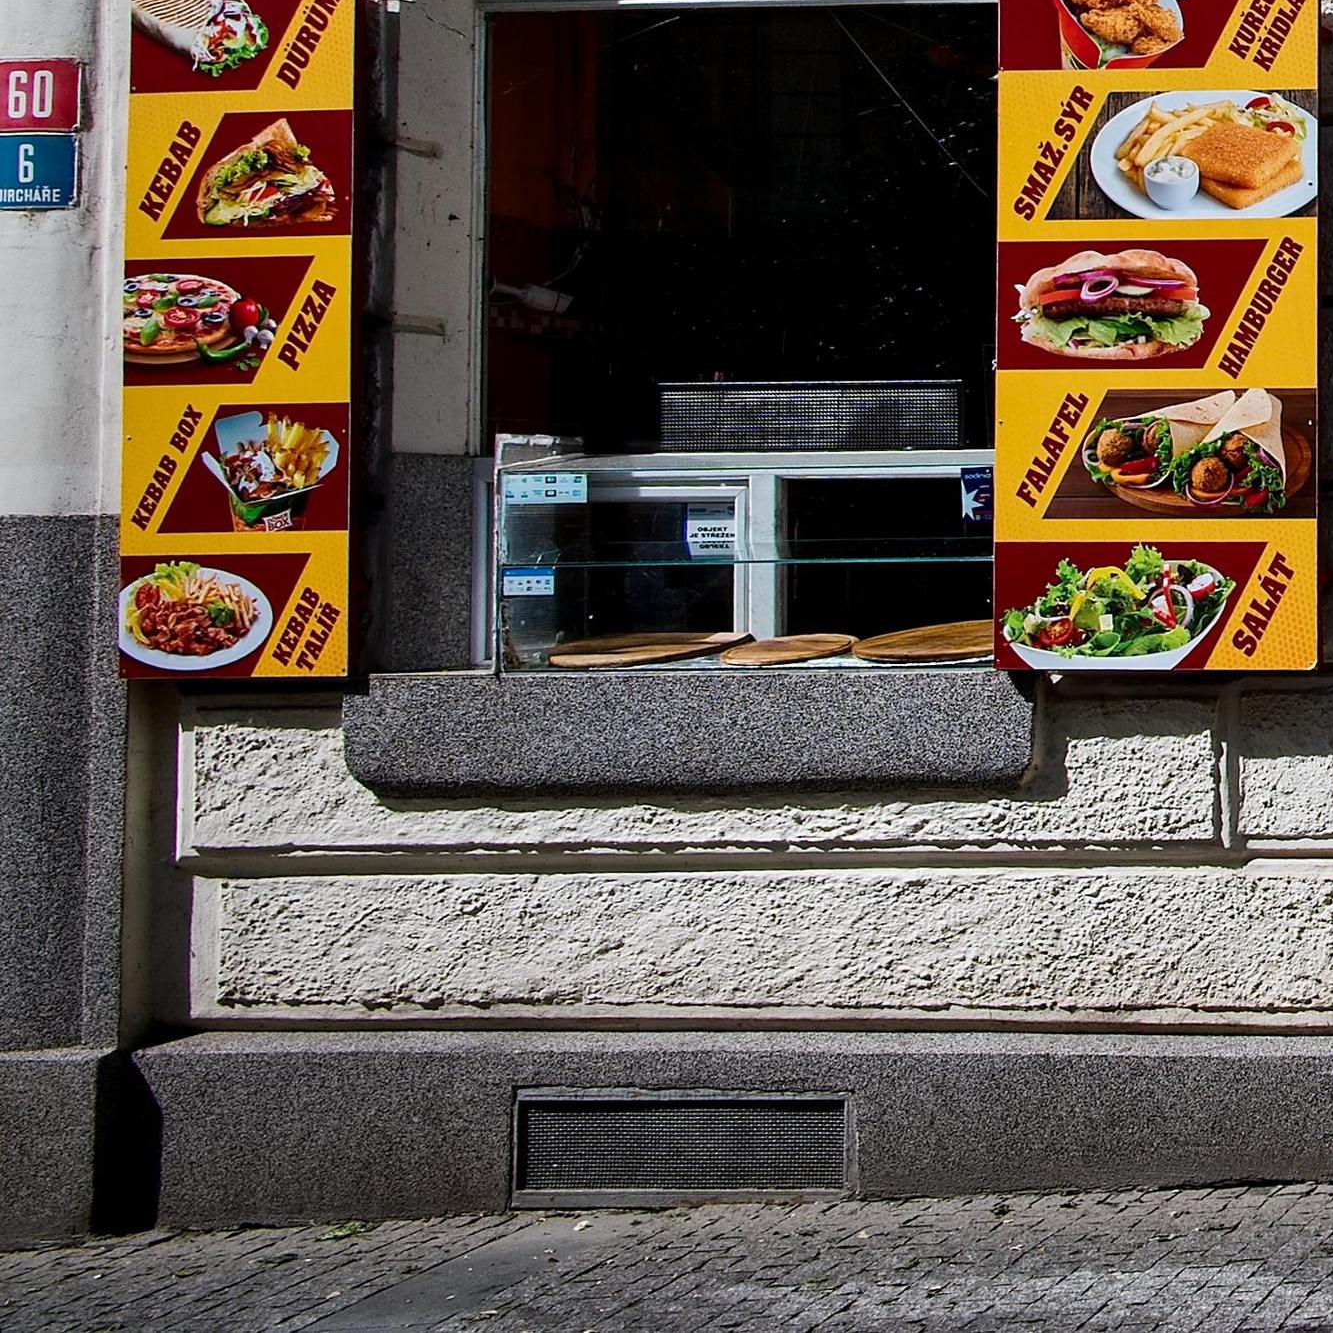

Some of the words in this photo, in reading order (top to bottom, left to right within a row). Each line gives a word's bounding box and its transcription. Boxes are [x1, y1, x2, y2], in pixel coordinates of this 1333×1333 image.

[8, 70, 54, 118] 60
[18, 144, 34, 183] 6
[138, 120, 201, 222] KEBAB
[278, 279, 337, 372] PIZZA
[1218, 236, 1304, 380] HAMBURGER
[131, 453, 178, 531] KEBAB
[169, 403, 203, 454] BOX
[1015, 391, 1089, 509] FALAFEL
[272, 587, 320, 667] KEBAB
[295, 601, 341, 672] TALÍŘ
[1232, 552, 1297, 658] SALÁT
